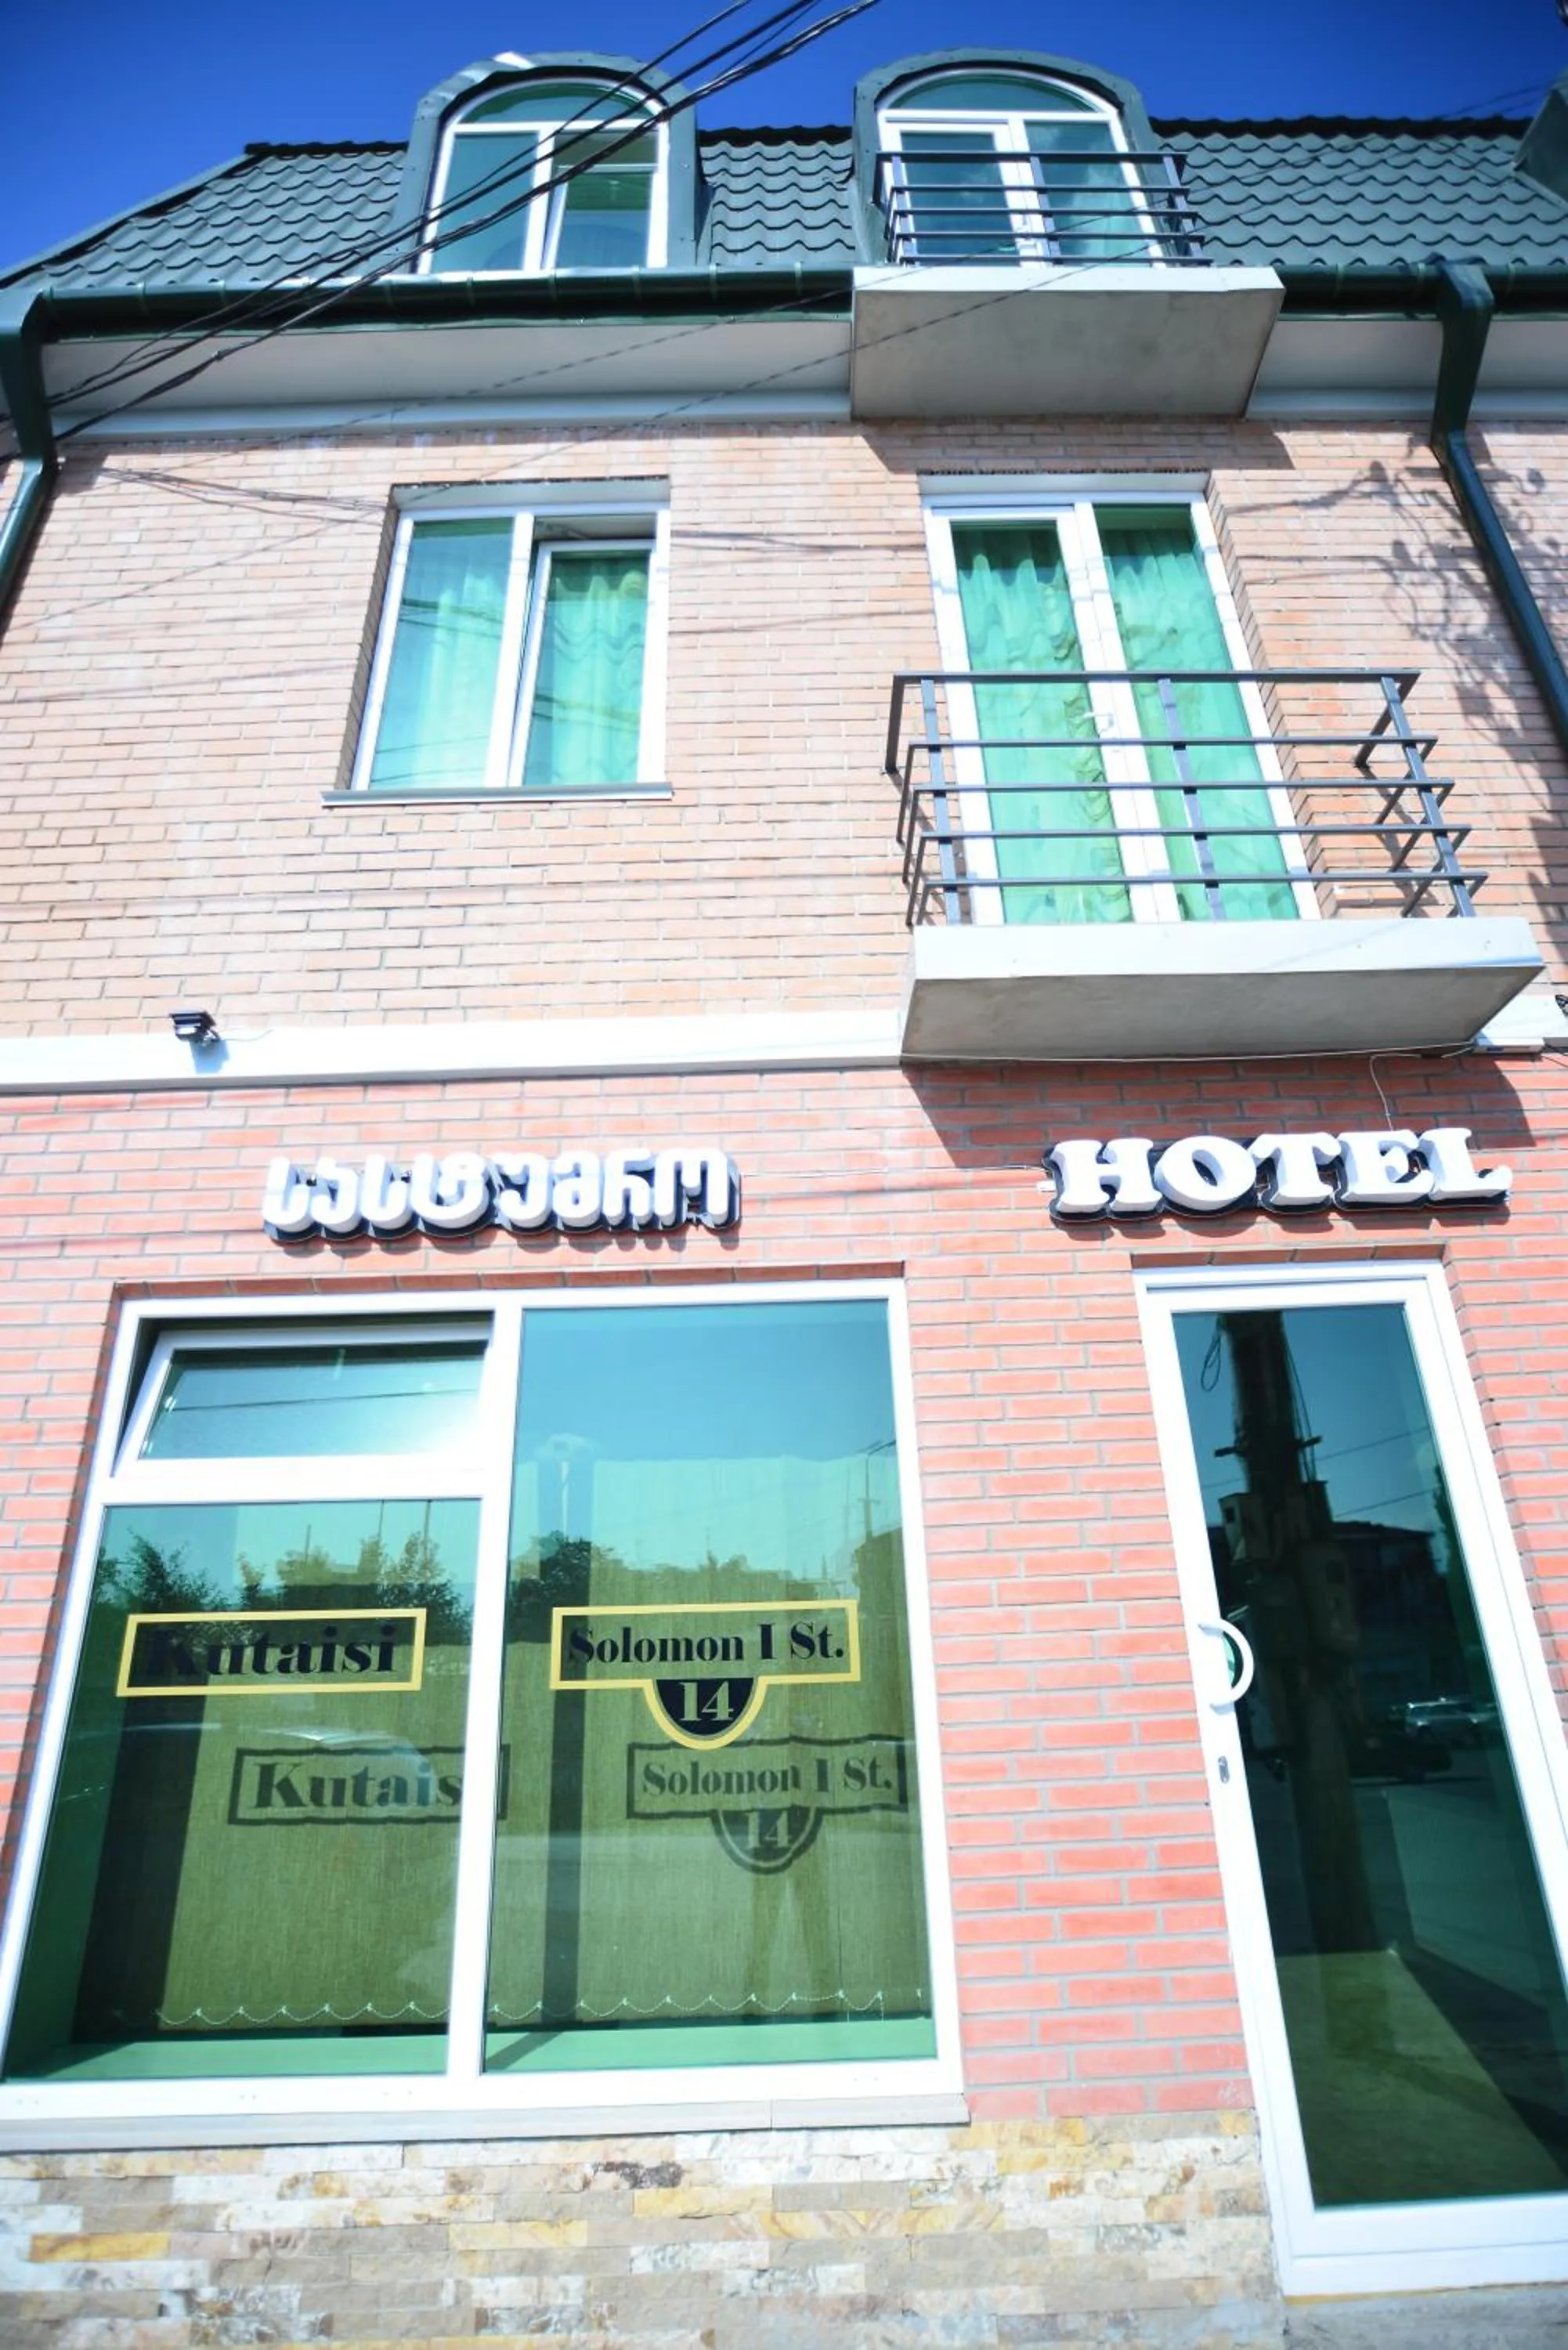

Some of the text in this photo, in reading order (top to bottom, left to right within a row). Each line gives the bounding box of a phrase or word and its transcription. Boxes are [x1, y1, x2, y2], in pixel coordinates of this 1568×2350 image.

[262, 1148, 739, 1241] სასტუმრო
[1045, 1128, 1513, 1220] HOTEL
[144, 1625, 398, 1676] Kutaisi
[568, 1621, 844, 1664] Solomon I St.
[679, 1679, 734, 1722] 14
[254, 1761, 464, 1809] Kutais
[642, 1756, 892, 1797] Solomon I St.
[746, 1810, 793, 1850] 14
